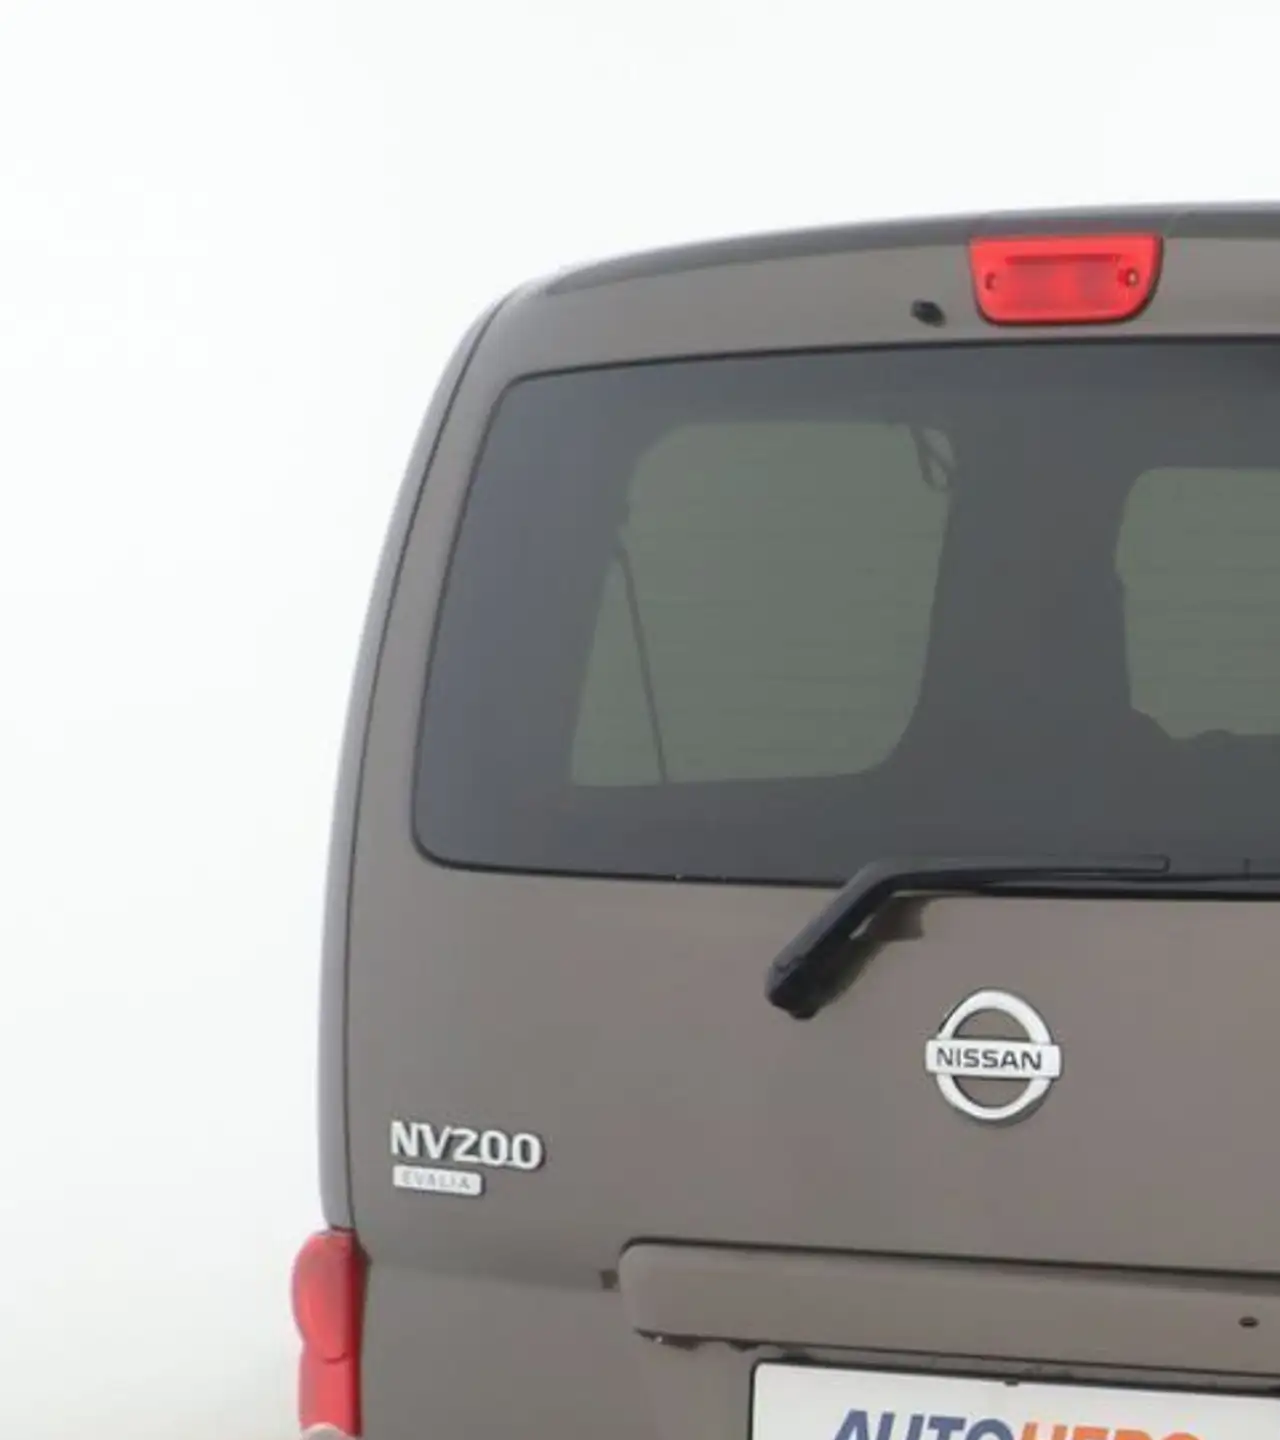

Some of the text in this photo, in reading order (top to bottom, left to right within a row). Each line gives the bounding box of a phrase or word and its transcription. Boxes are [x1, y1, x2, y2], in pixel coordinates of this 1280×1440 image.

[936, 1046, 1043, 1072] NISSAN
[390, 1120, 543, 1170] NV200
[401, 1172, 473, 1191] EVALIA
